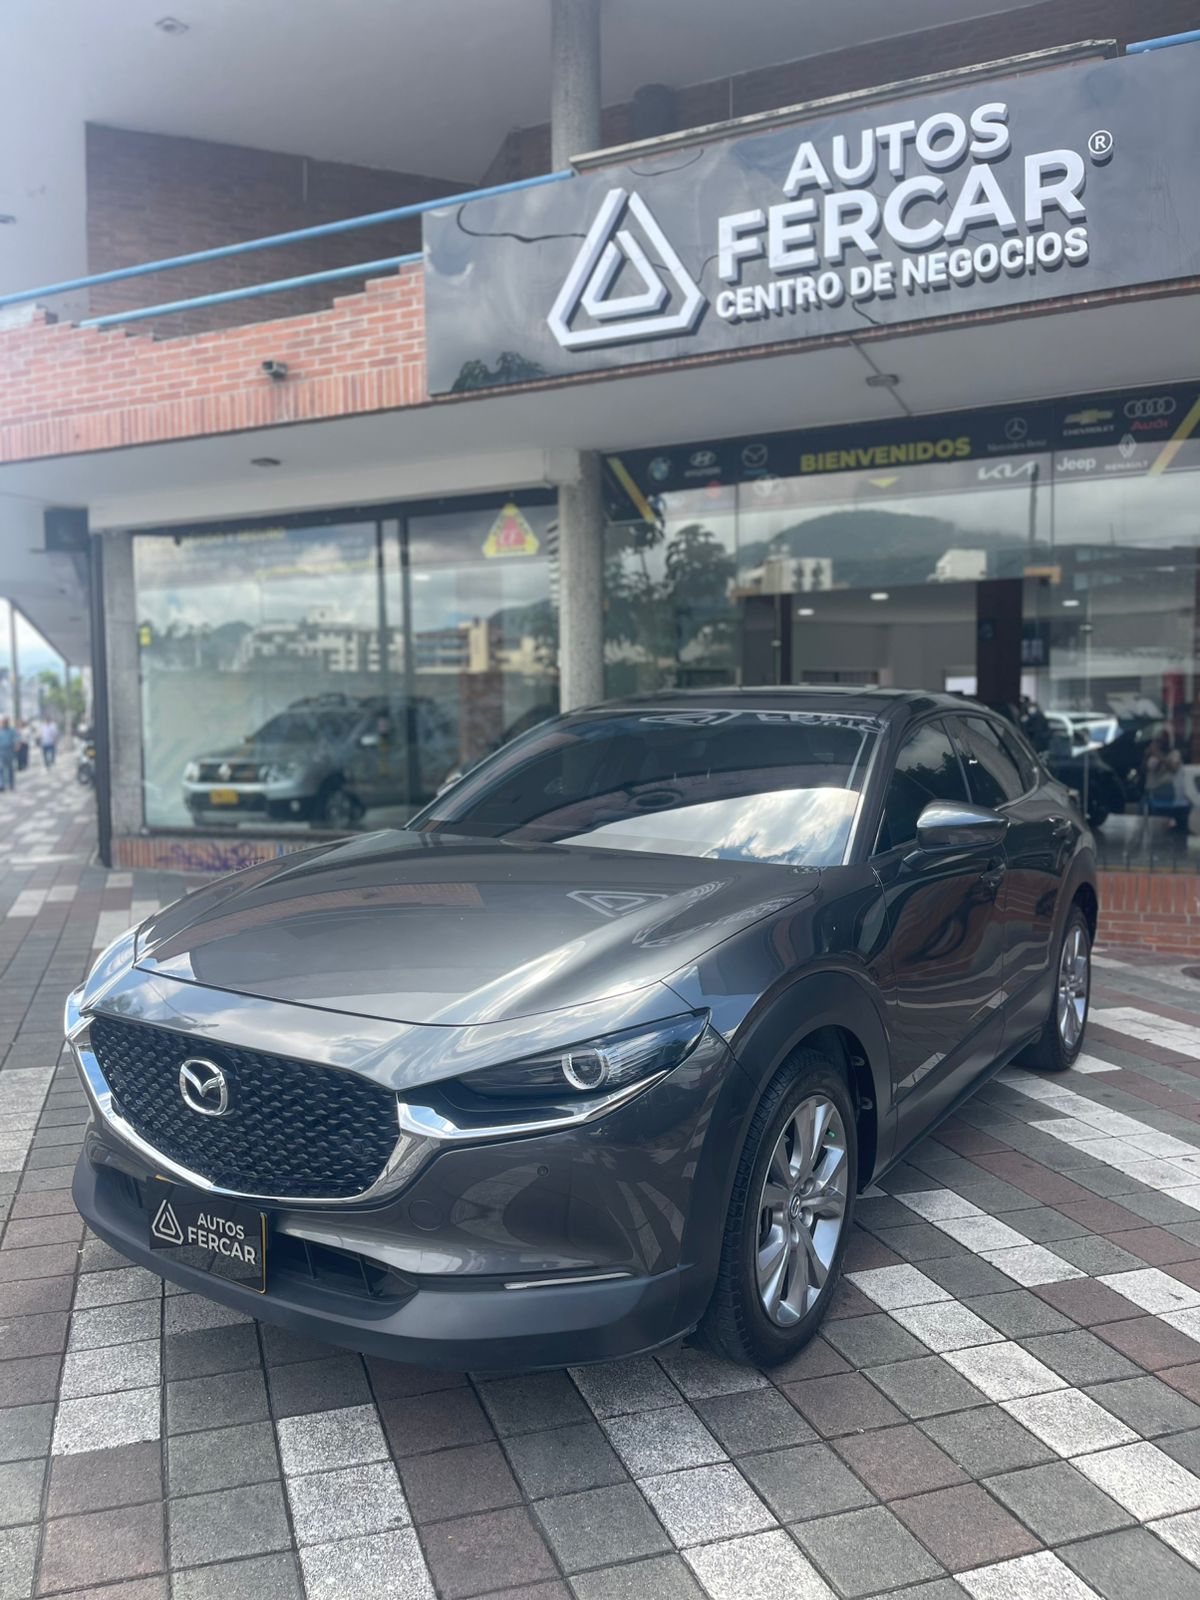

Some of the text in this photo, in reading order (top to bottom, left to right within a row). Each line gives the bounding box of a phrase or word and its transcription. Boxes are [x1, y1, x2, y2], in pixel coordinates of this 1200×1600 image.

[782, 102, 1010, 198] AUTOS
[717, 148, 1087, 282] FERCAR
[715, 226, 1090, 321] CENTRO DE NEGOCIOS
[801, 437, 970, 472] BIENVENIDOS
[1056, 456, 1097, 473] Jeep
[187, 1226, 256, 1265] FERCAR
[197, 1212, 245, 1240] AUTOS
